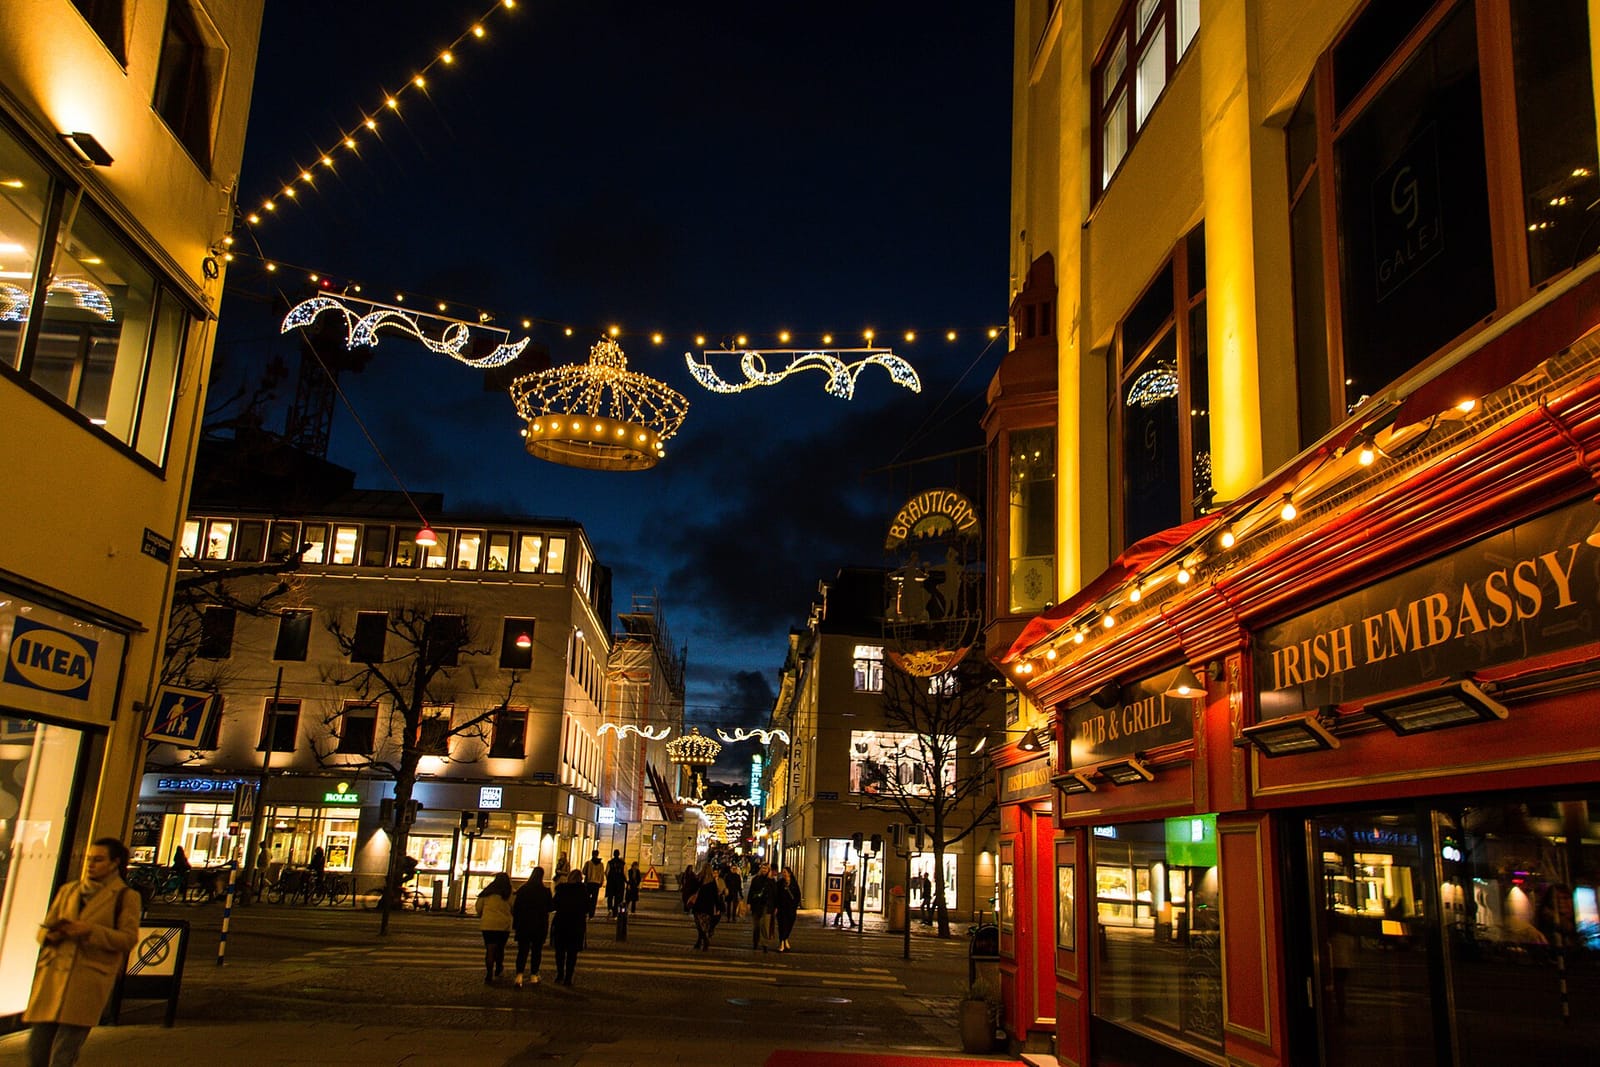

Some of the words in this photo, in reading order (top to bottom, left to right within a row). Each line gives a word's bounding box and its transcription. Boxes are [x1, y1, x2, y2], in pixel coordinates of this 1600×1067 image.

[889, 490, 978, 539] BRÄUTIGAM
[1272, 624, 1356, 691] IRISH
[1364, 542, 1580, 665] EMBASSY
[17, 638, 87, 680] IKEA
[1081, 715, 1106, 746] PUB
[1108, 710, 1119, 741] &
[1122, 692, 1172, 736] GRILL
[792, 737, 802, 796] ARKET
[325, 793, 358, 802] ROLEX
